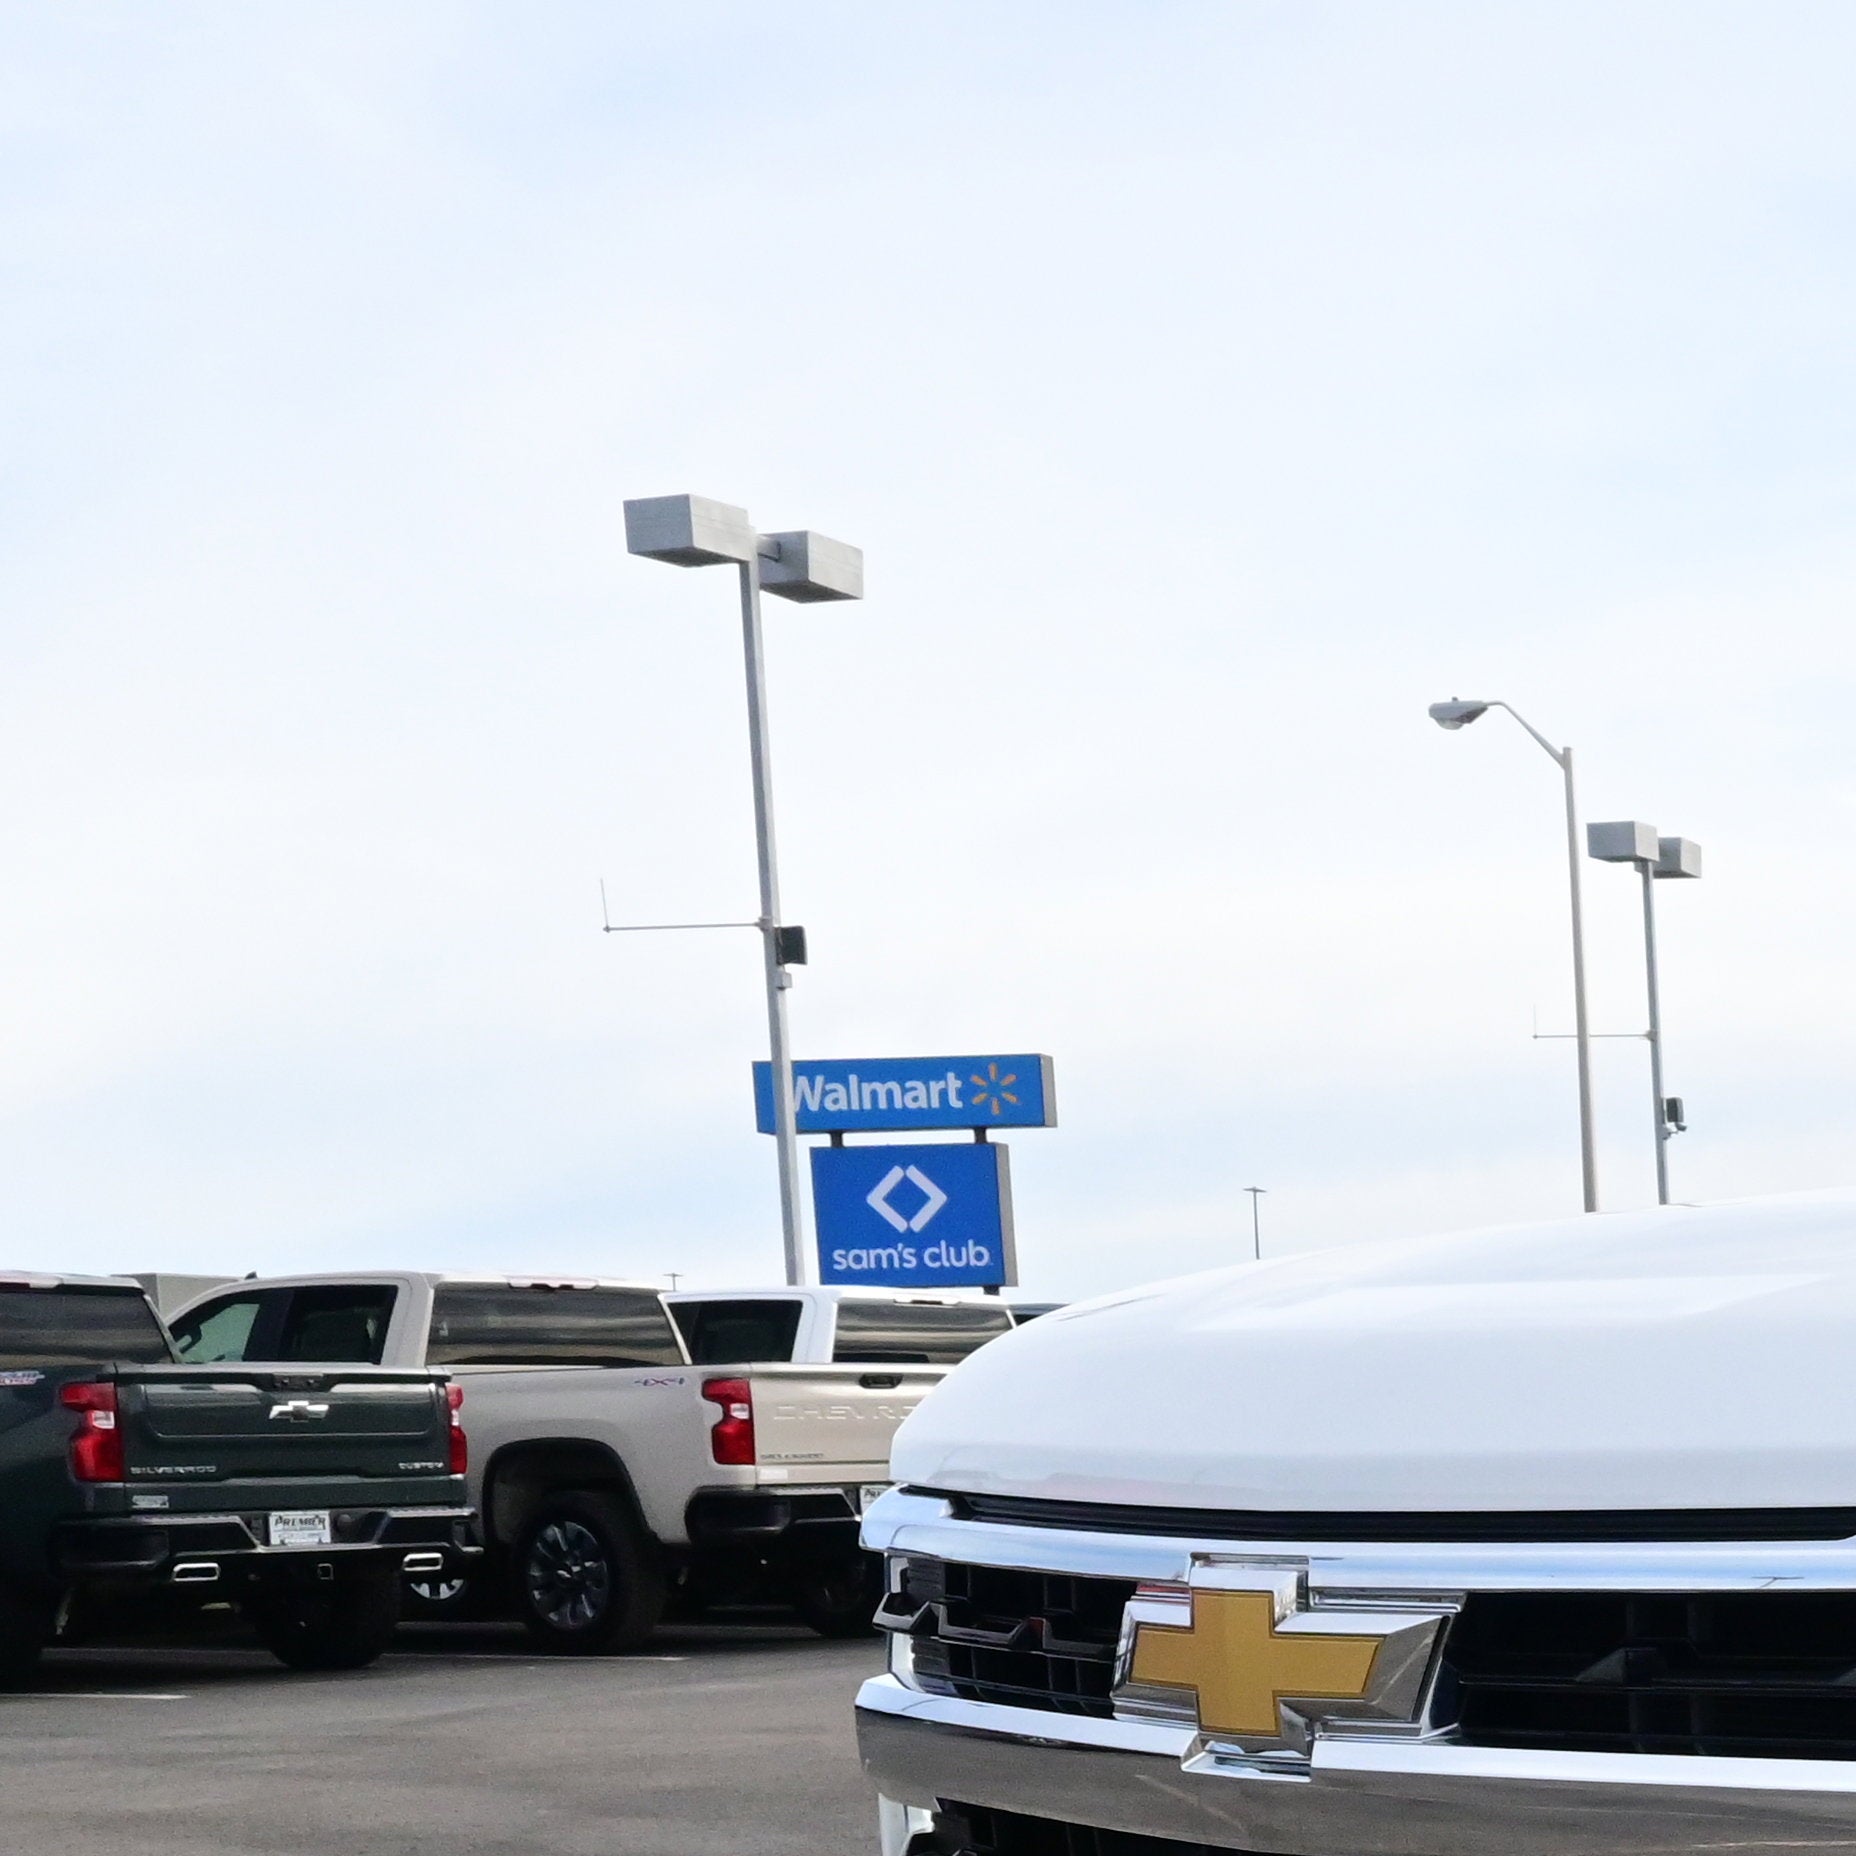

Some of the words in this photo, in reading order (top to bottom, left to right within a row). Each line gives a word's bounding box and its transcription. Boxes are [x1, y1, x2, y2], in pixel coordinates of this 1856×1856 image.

[793, 1072, 963, 1112] Walmart
[832, 1243, 917, 1270] sam's
[923, 1240, 990, 1267] club
